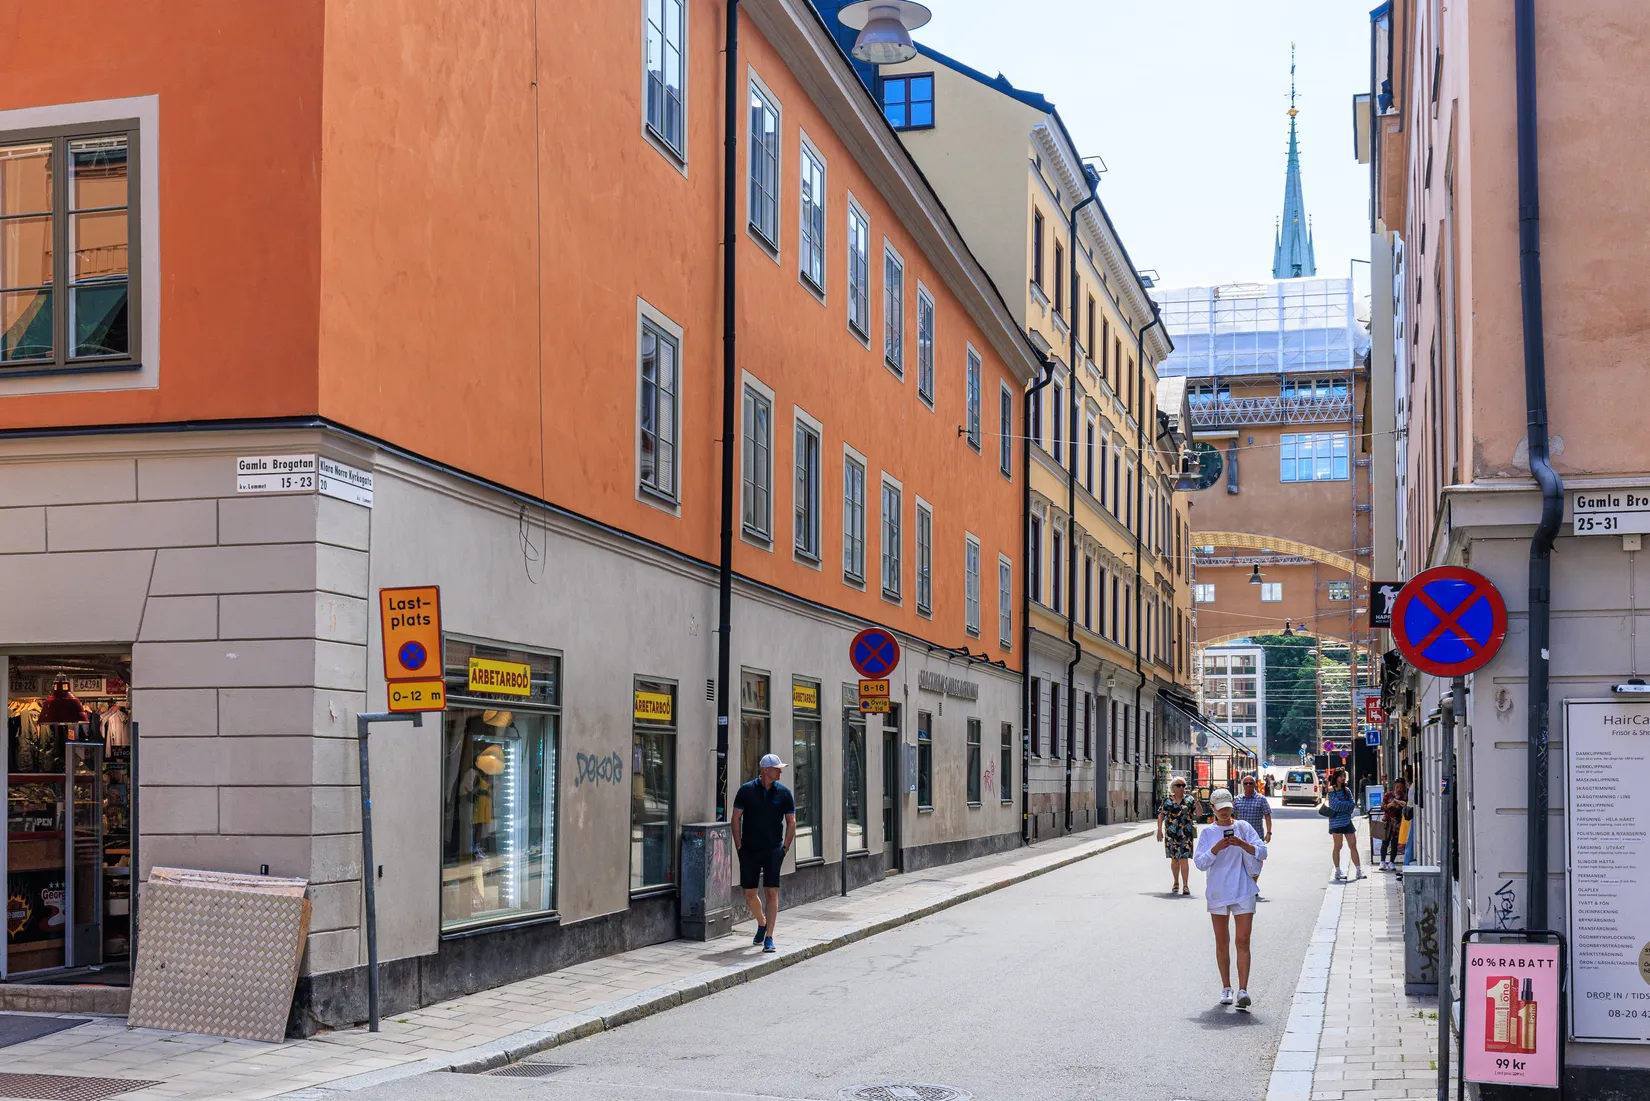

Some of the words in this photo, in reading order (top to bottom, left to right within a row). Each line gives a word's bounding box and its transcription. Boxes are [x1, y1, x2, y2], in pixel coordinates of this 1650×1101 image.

[239, 459, 267, 470] Gamla
[272, 459, 313, 471] Brogatan
[320, 461, 333, 473] Klara
[335, 465, 348, 478] Norra
[320, 480, 327, 490] 20
[1577, 494, 1620, 508] Gamla
[1578, 517, 1618, 530] 25-31
[389, 597, 431, 611] Last-
[391, 613, 431, 630] plats
[471, 667, 528, 689] ARBETARBOD
[863, 684, 885, 692] 8-18
[393, 691, 422, 701] 0-12
[431, 692, 441, 701] m
[871, 698, 888, 706] Övrig
[1471, 958, 1484, 967] 60
[1486, 958, 1496, 967] %
[1499, 959, 1554, 968] RABATT
[1586, 991, 1610, 999] DROP
[1608, 1009, 1638, 1018] 08-20
[1496, 1058, 1510, 1069] 99
[1513, 1059, 1526, 1070] kr
